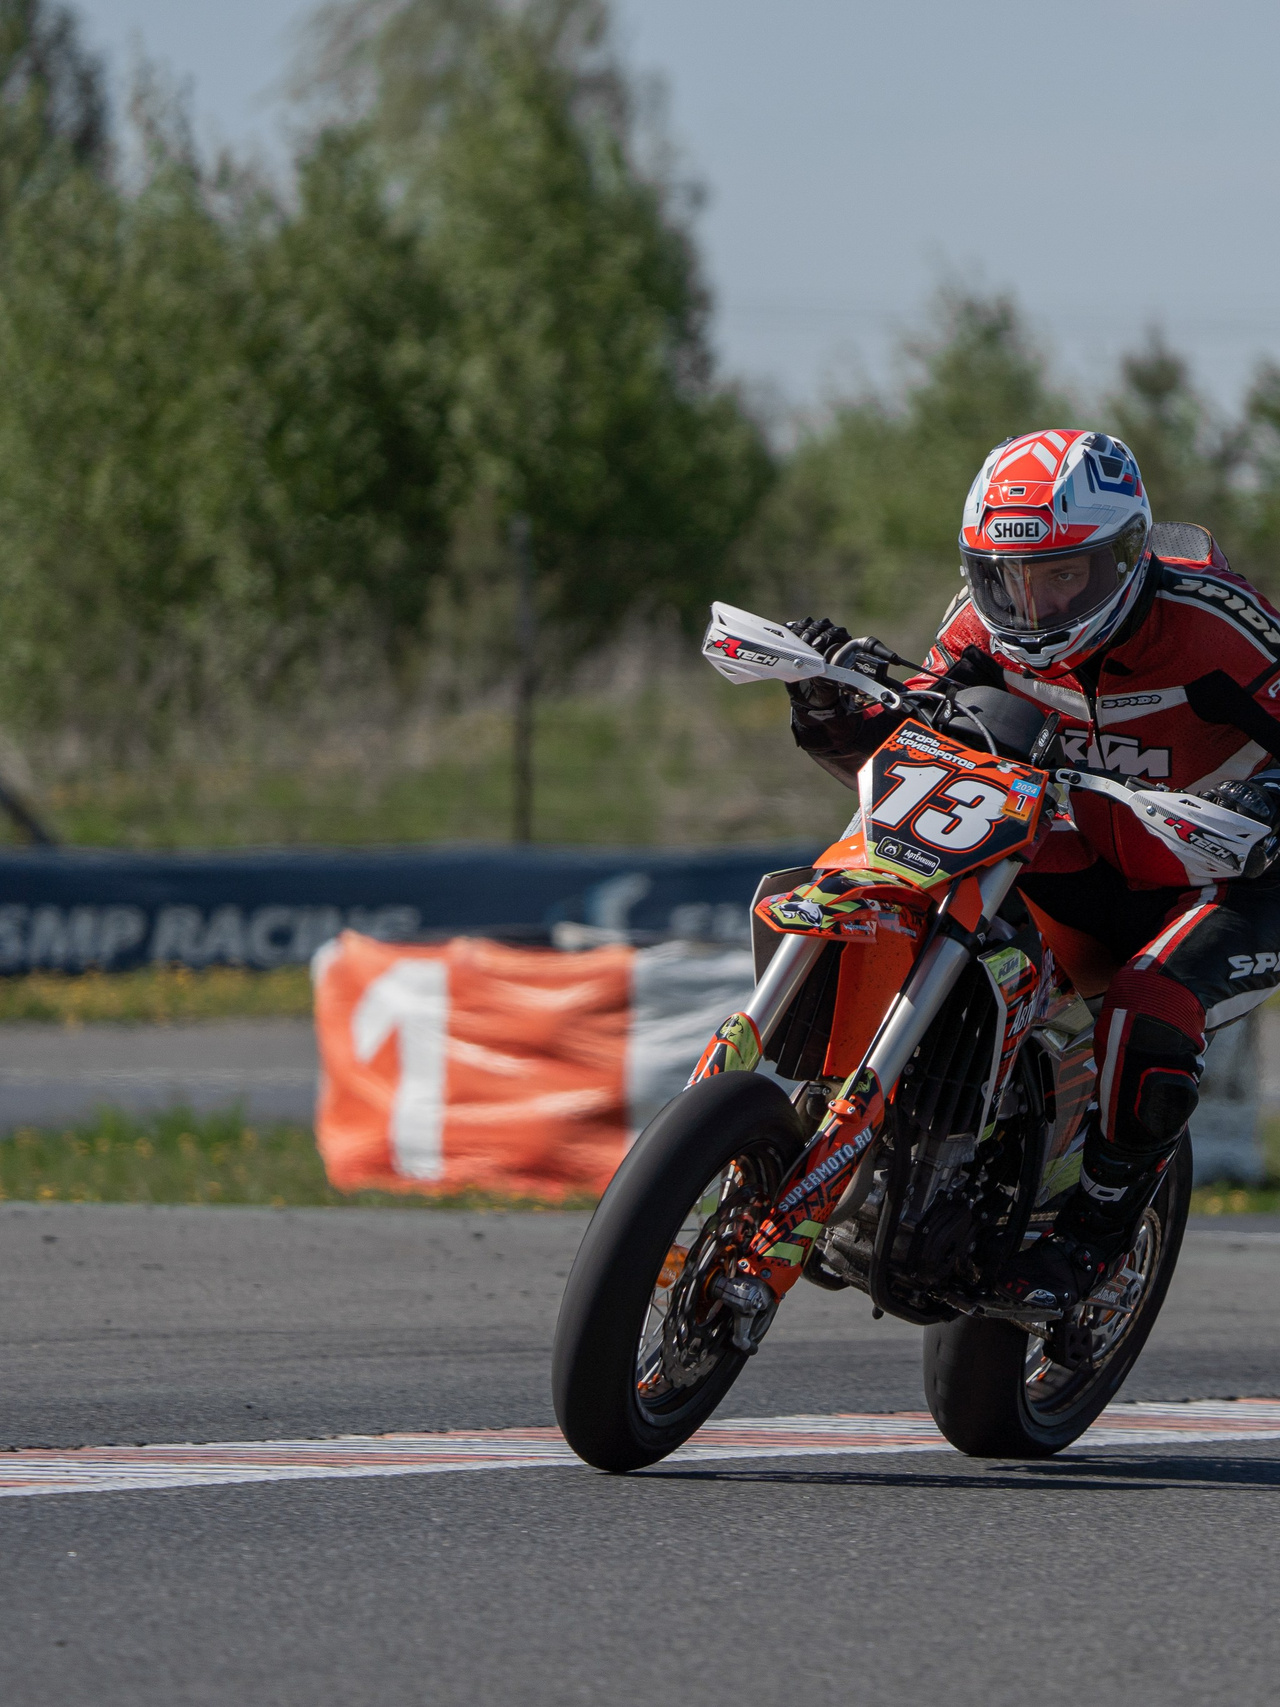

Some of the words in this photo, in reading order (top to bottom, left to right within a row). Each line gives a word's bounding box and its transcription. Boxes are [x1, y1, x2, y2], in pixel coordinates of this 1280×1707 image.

[994, 521, 1040, 539] SHOEI
[1101, 694, 1162, 709] SPIDI
[900, 728, 941, 748] ИГОРЬ
[895, 736, 978, 771] КРИВОРОТОВ
[1060, 729, 1170, 777] KTM
[1014, 781, 1039, 795] 2024
[868, 764, 1009, 850] 13
[1014, 793, 1028, 812] 1
[353, 957, 450, 1181] 1
[778, 1126, 873, 1213] SUPERMOTO.RU
